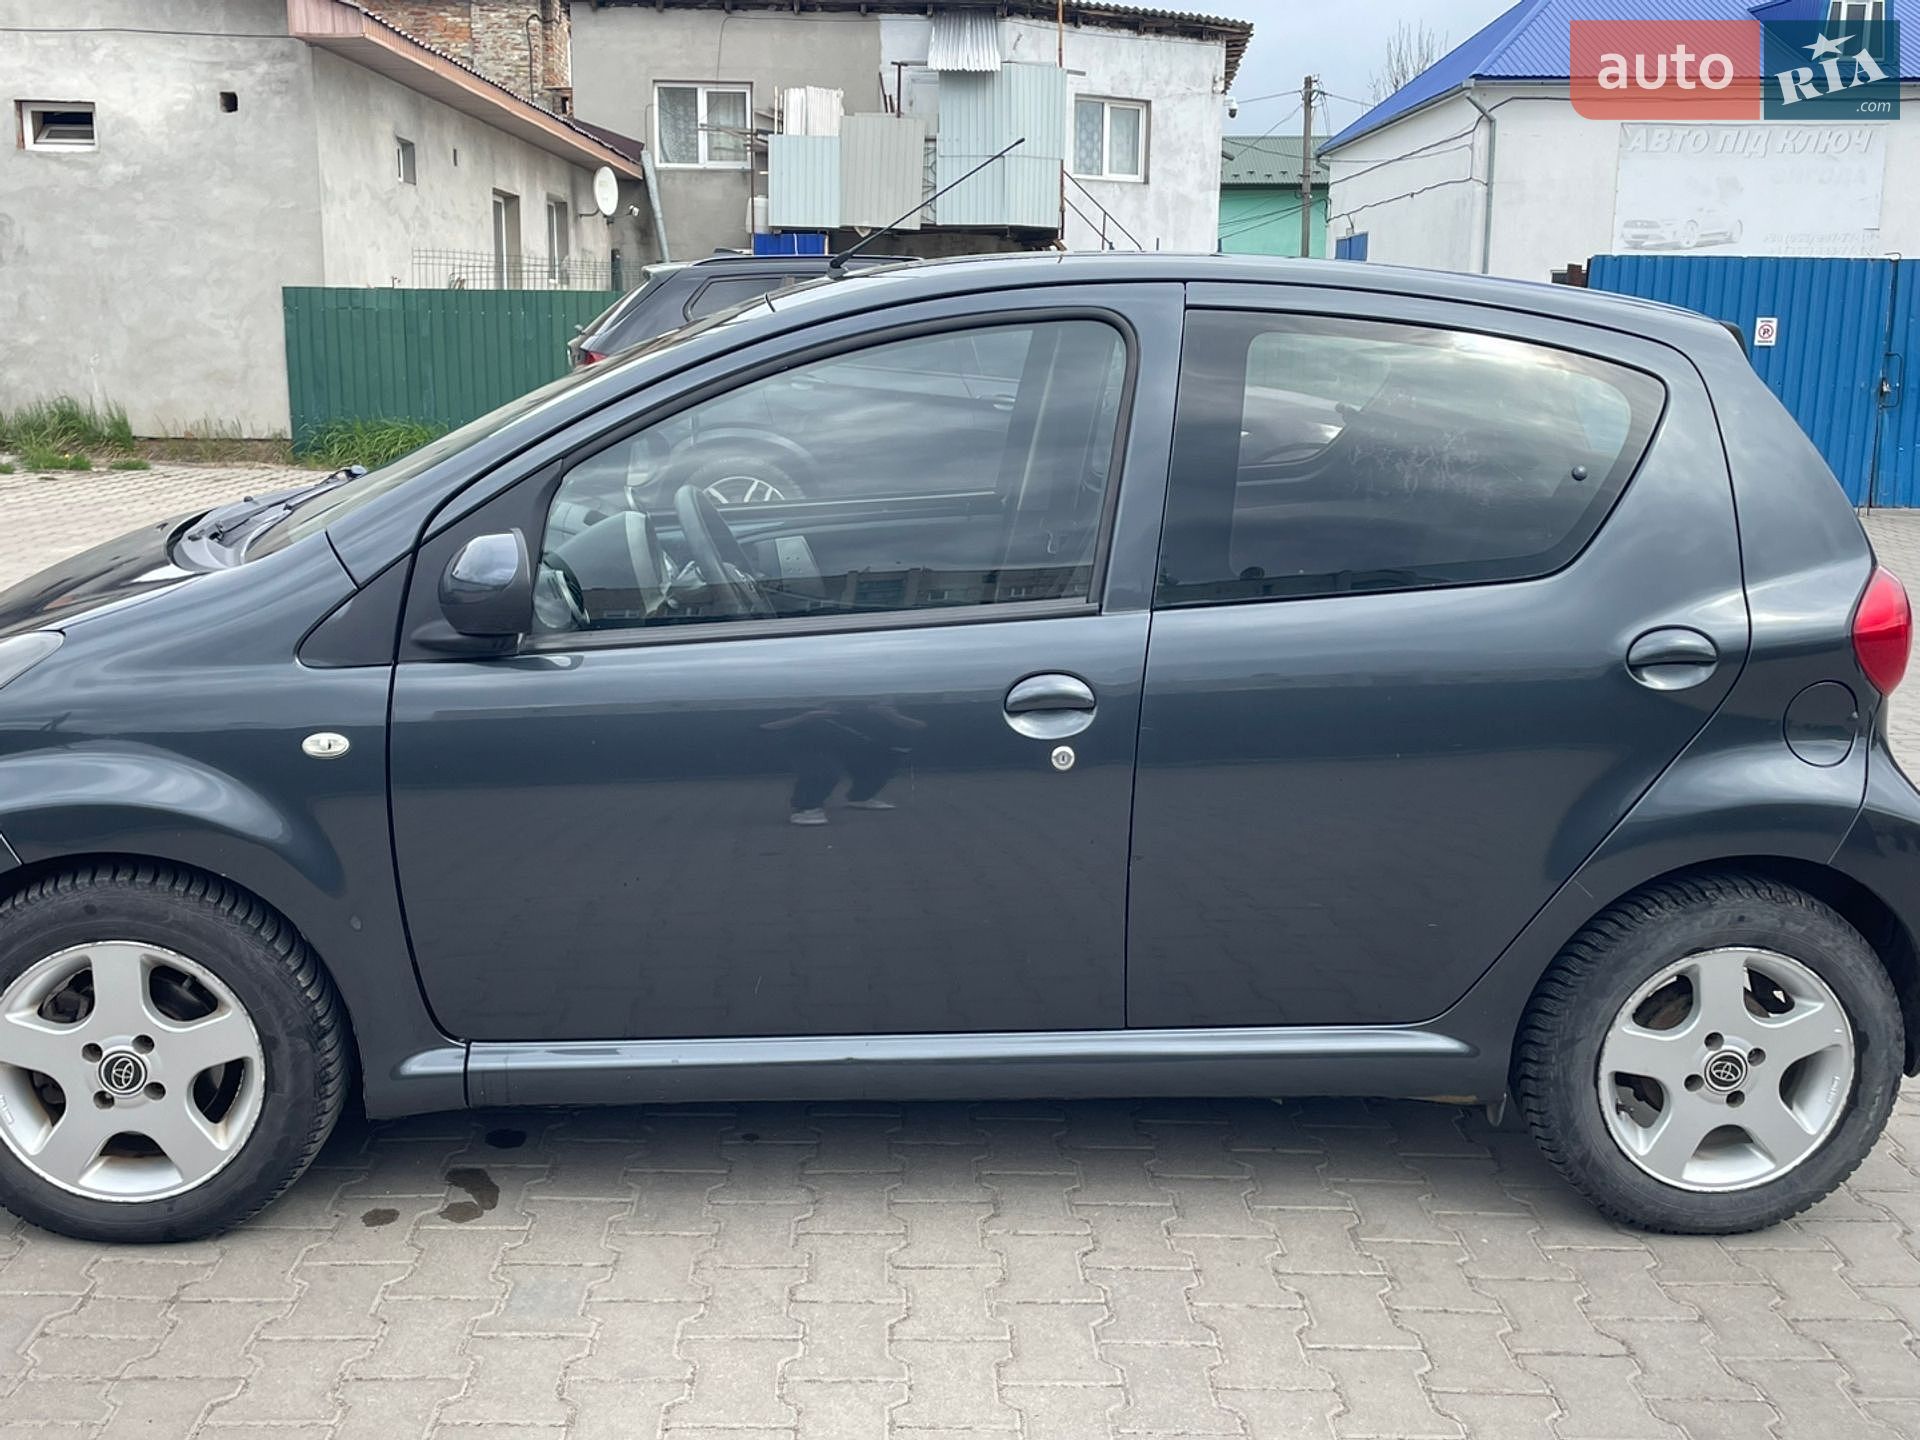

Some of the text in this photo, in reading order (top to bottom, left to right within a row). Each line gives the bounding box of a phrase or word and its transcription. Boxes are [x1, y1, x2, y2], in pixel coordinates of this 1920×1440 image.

[1627, 128, 1873, 159] АВТО ПІД КЛЮЧ
